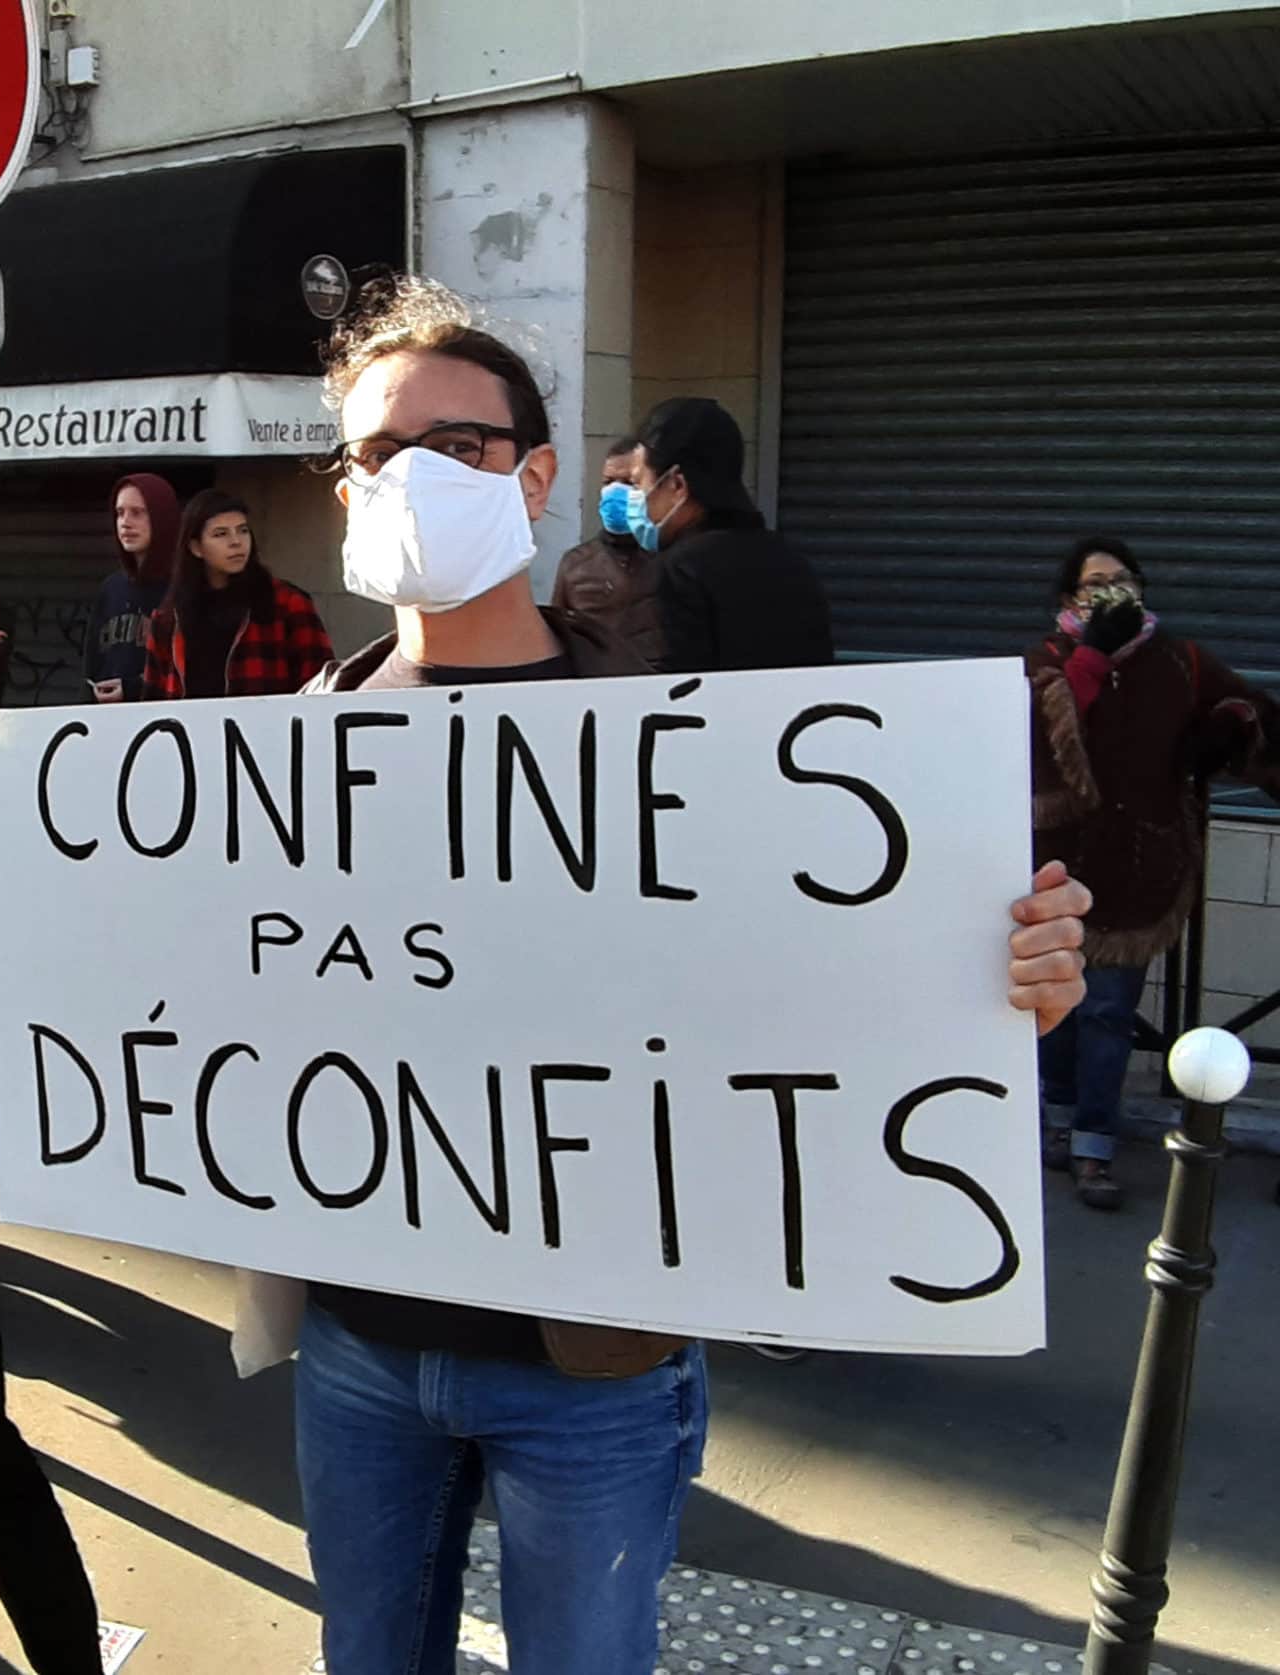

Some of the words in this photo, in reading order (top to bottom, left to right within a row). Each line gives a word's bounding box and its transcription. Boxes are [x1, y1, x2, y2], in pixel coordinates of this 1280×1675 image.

[247, 418, 290, 442] Vente
[293, 416, 303, 442] à
[250, 911, 455, 989] PAS
